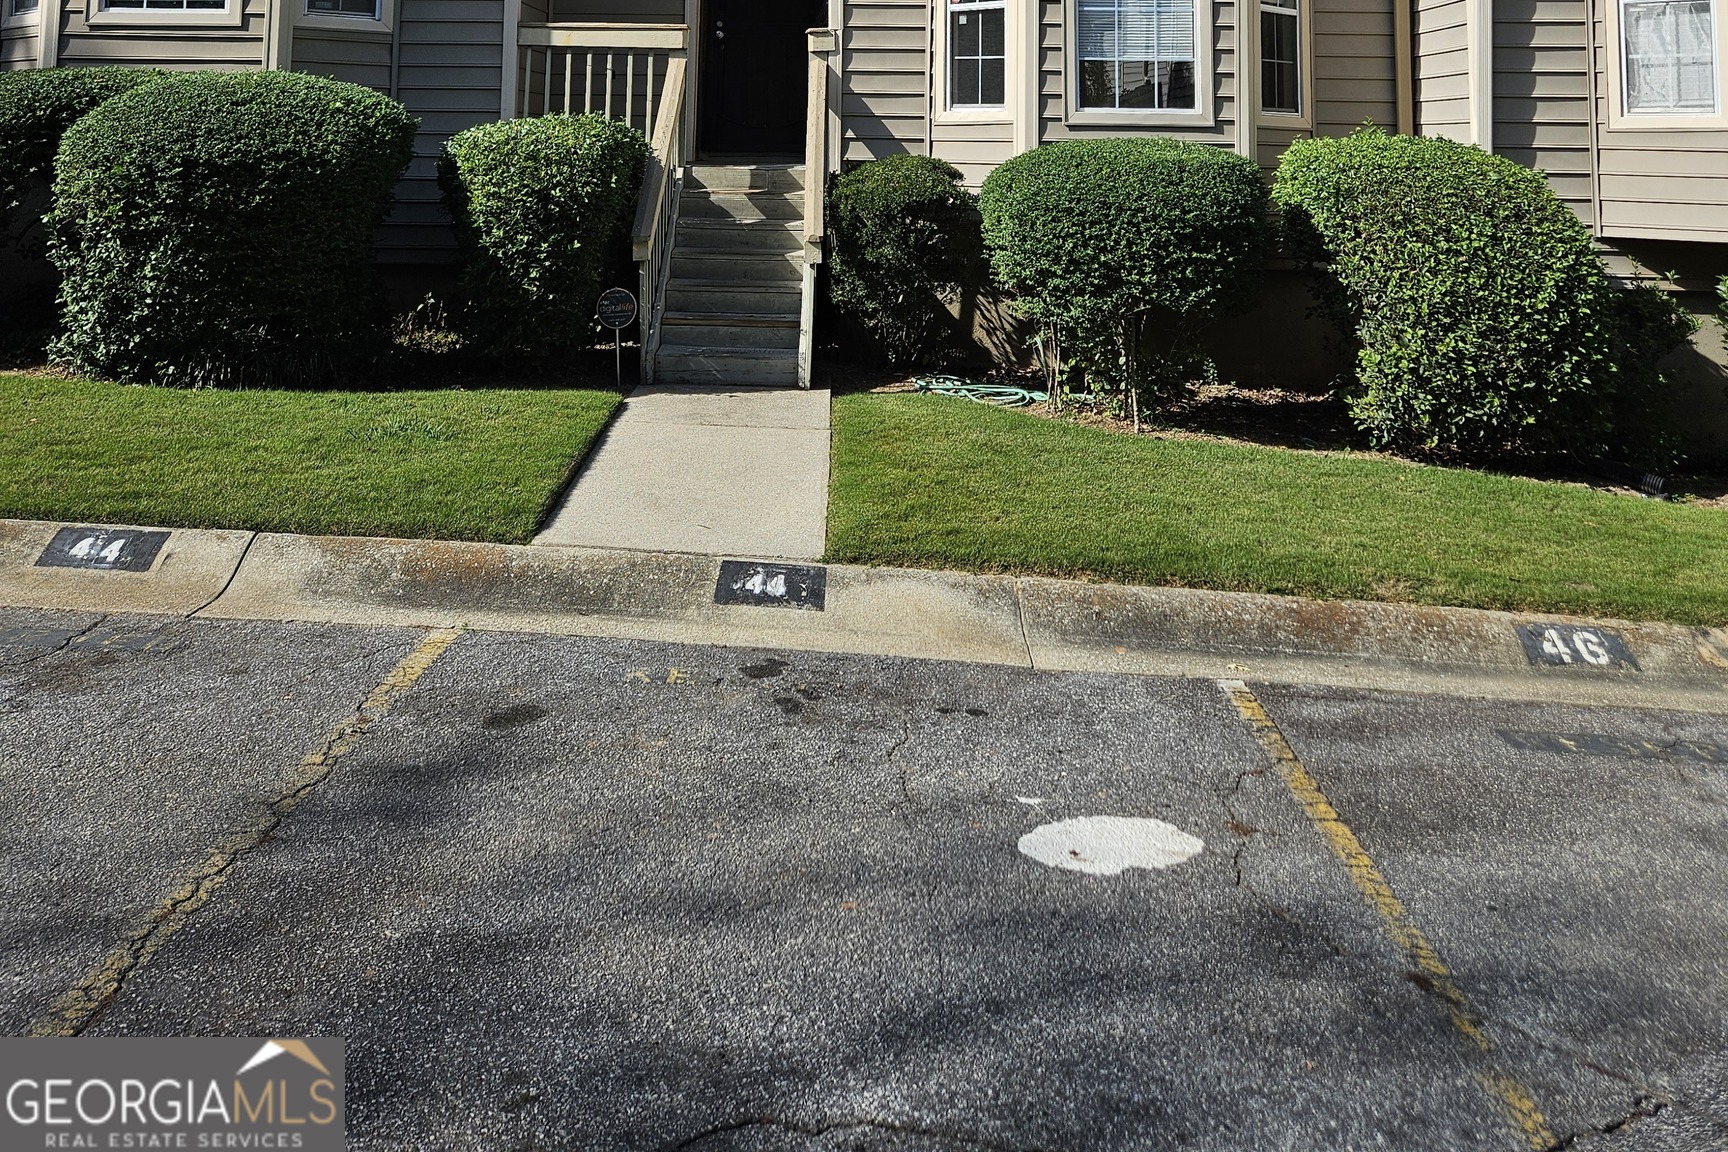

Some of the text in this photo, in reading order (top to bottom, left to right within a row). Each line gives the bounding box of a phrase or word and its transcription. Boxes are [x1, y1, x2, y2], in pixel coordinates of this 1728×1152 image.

[68, 536, 126, 562] 44
[744, 572, 788, 597] 44
[1542, 628, 1610, 665] 46
